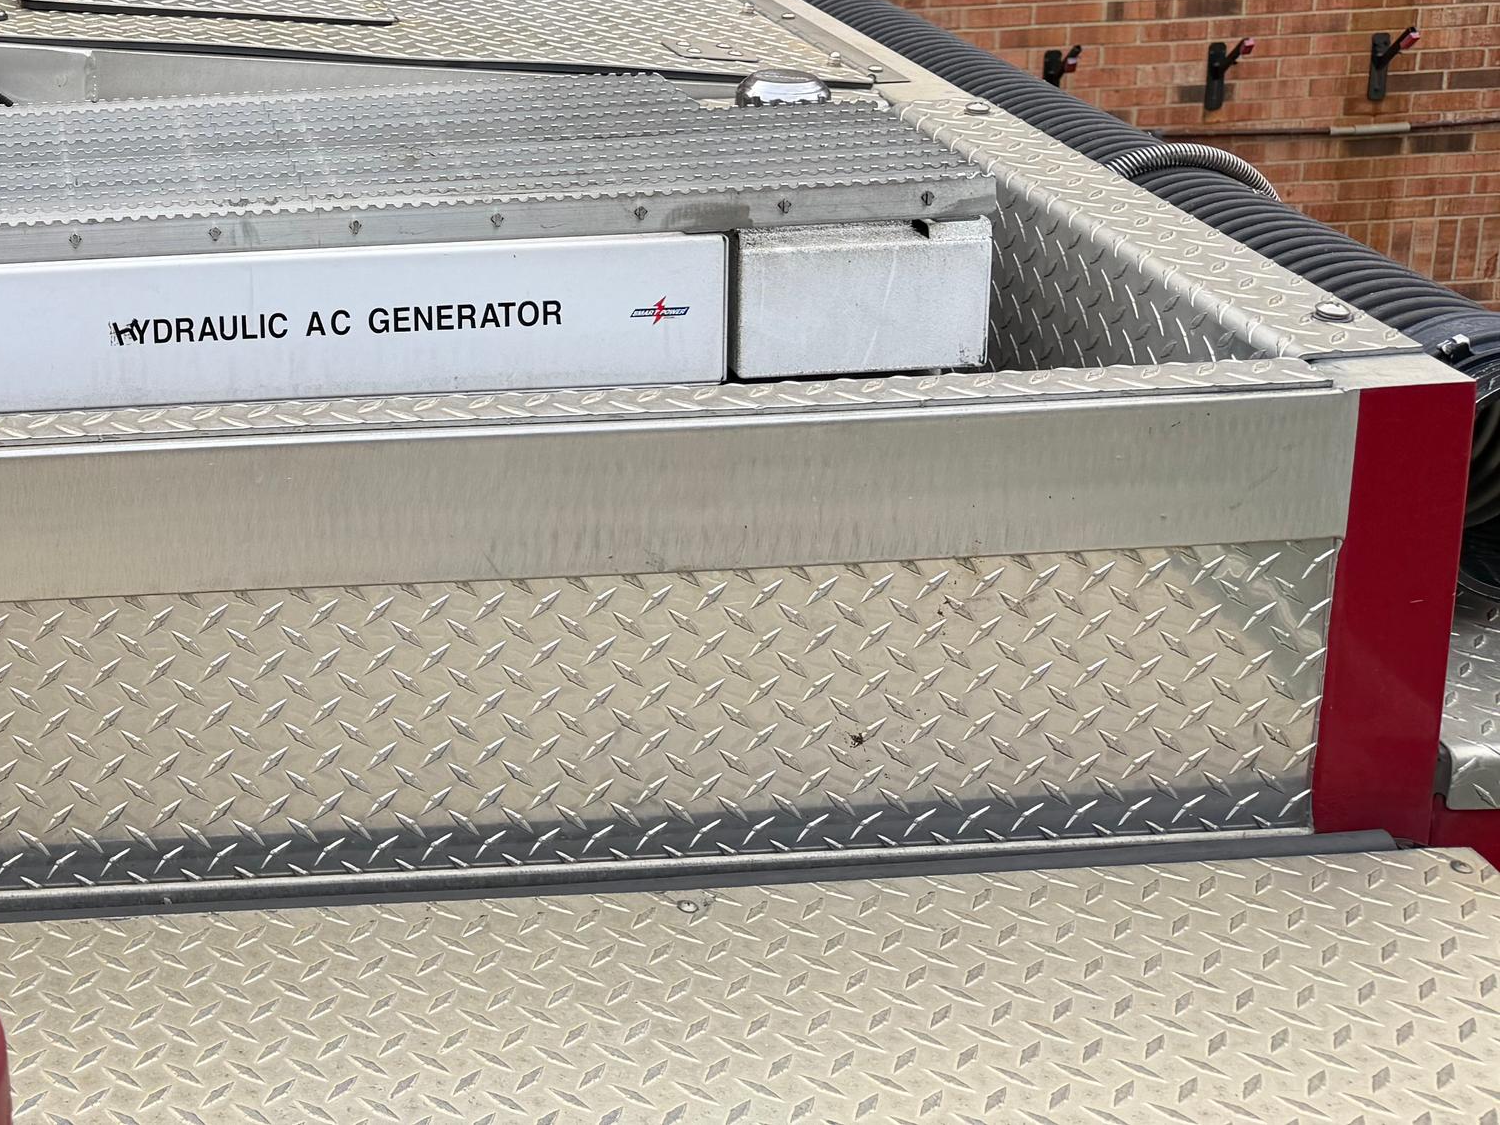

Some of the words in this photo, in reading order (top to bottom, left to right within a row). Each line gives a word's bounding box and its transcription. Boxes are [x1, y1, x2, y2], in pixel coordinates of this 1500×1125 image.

[110, 313, 288, 346] HYDRAULIC
[305, 309, 352, 337] AC
[367, 300, 562, 334] GENERATOR
[660, 307, 687, 315] POWER
